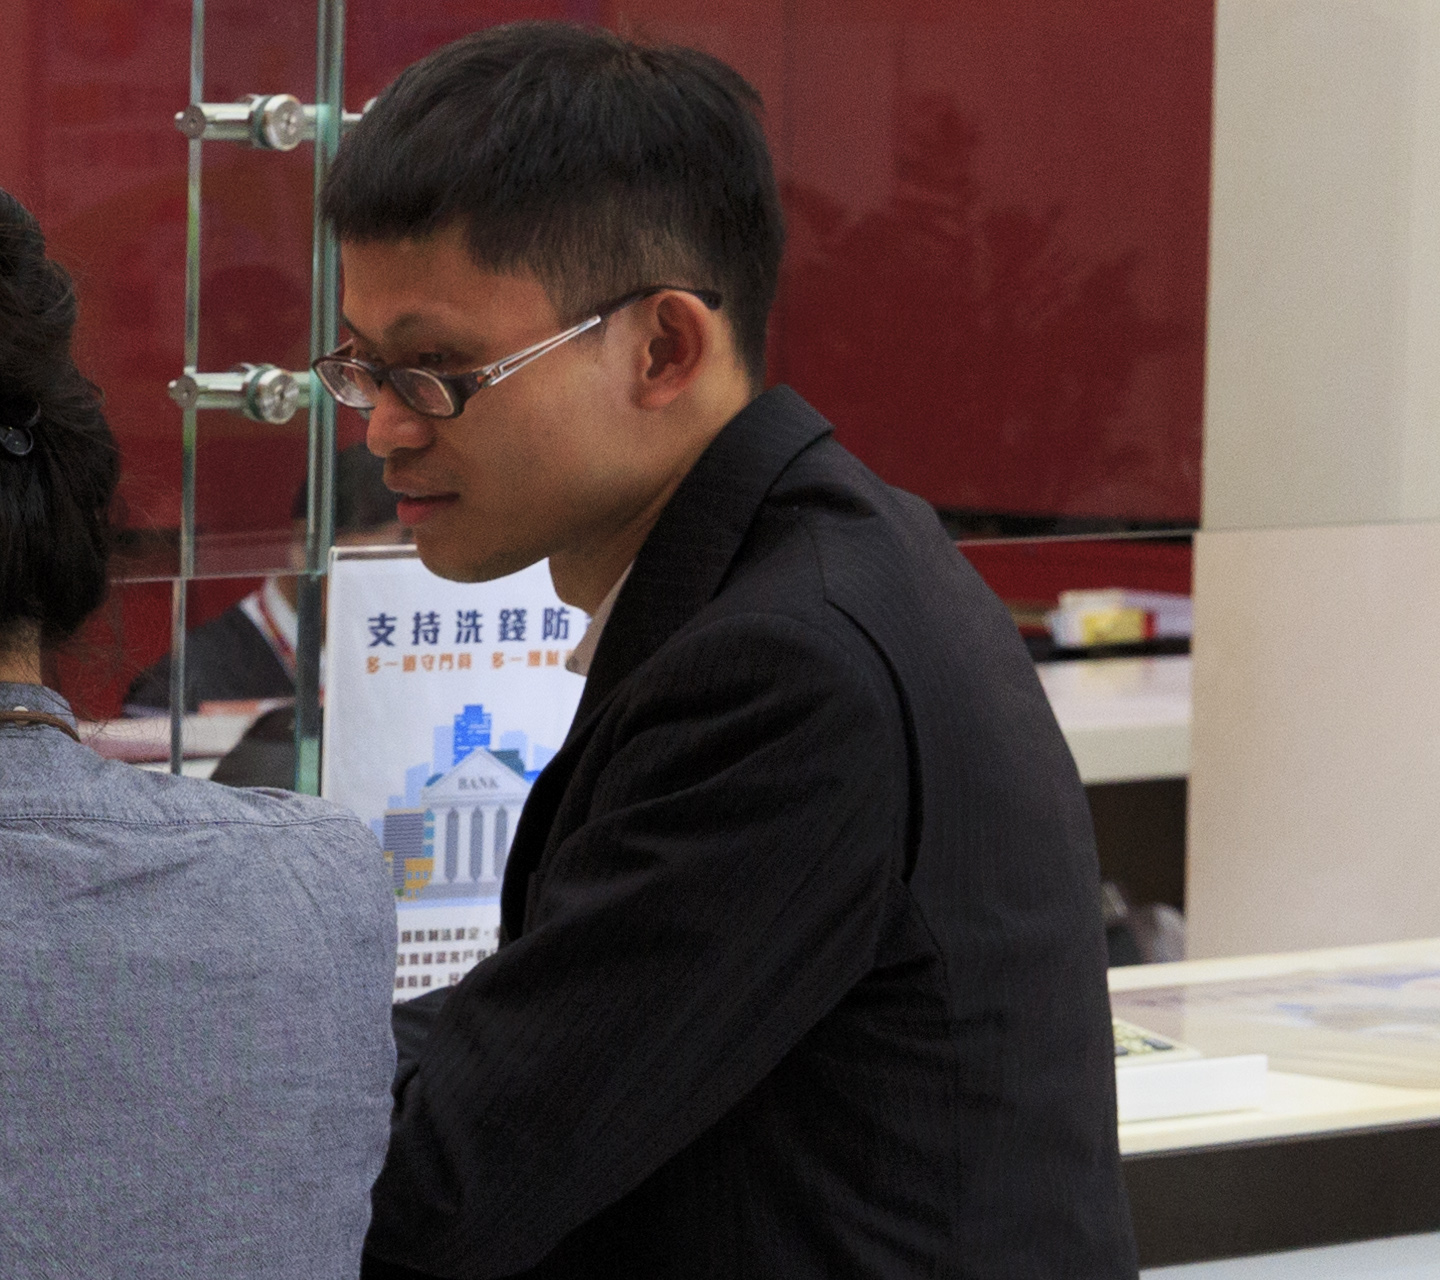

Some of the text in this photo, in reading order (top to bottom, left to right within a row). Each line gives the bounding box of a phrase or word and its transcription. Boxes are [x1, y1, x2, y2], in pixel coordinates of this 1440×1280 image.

[367, 606, 571, 648] 支持洗錢防
